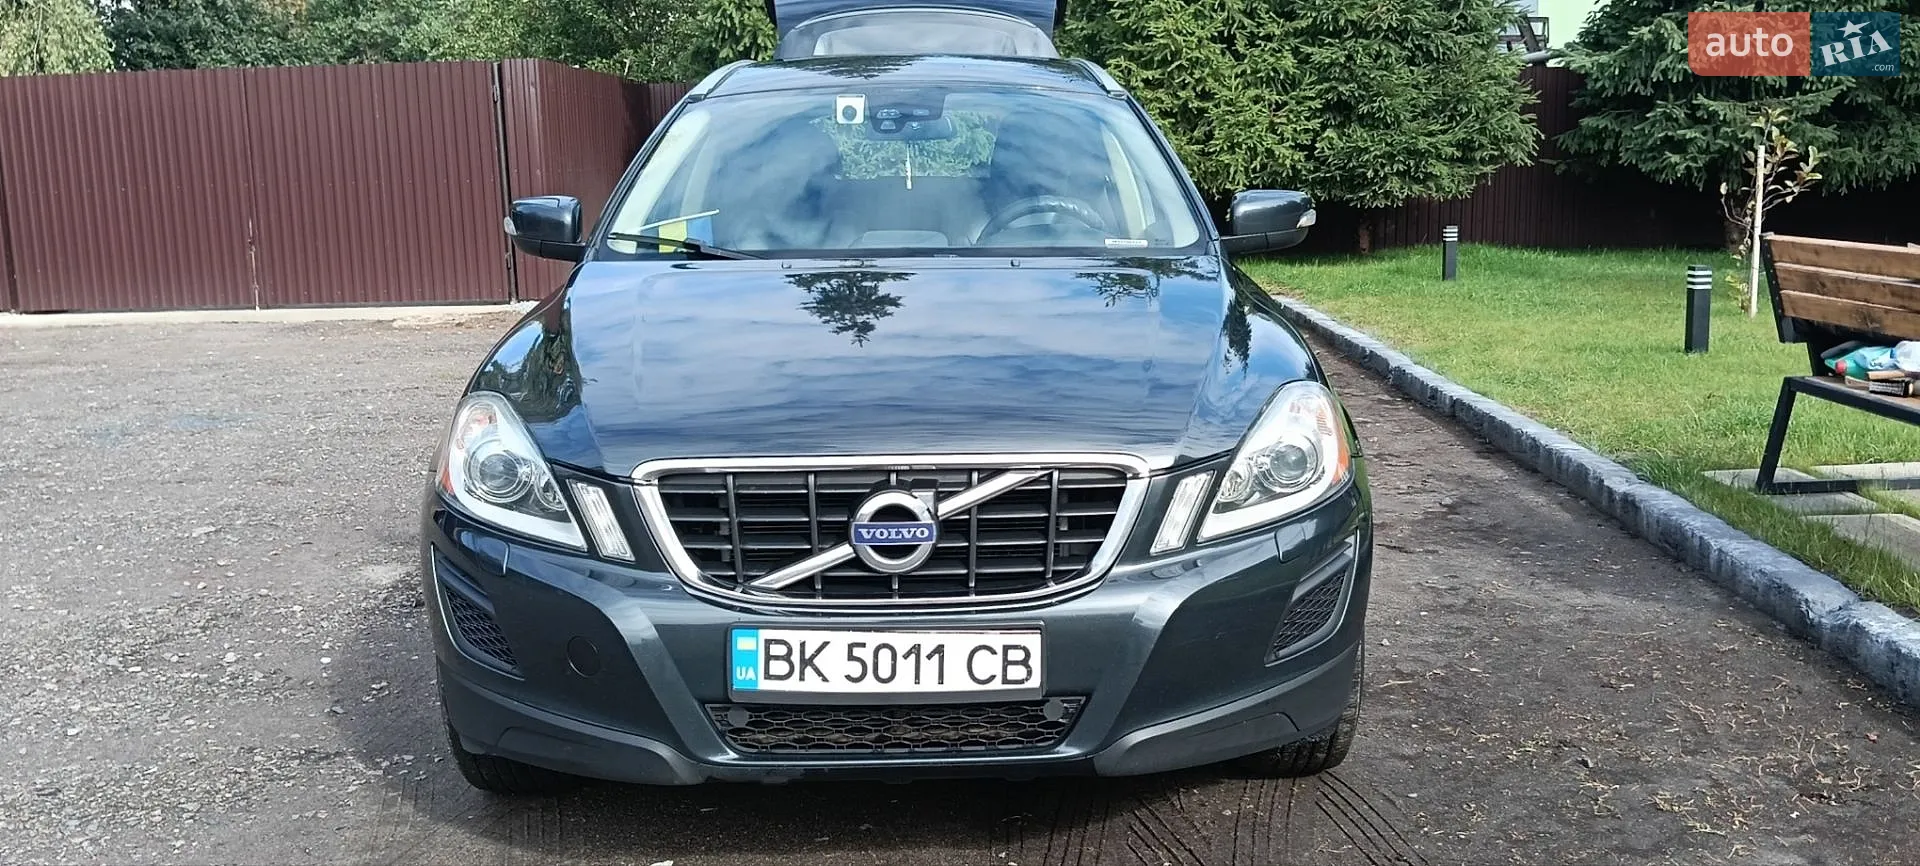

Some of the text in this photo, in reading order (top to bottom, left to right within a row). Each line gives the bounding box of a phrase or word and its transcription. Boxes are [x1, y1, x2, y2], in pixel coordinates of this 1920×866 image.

[858, 527, 929, 539] VOLVO
[763, 638, 1033, 685] BK 5011 CB
[736, 667, 756, 681] UA
